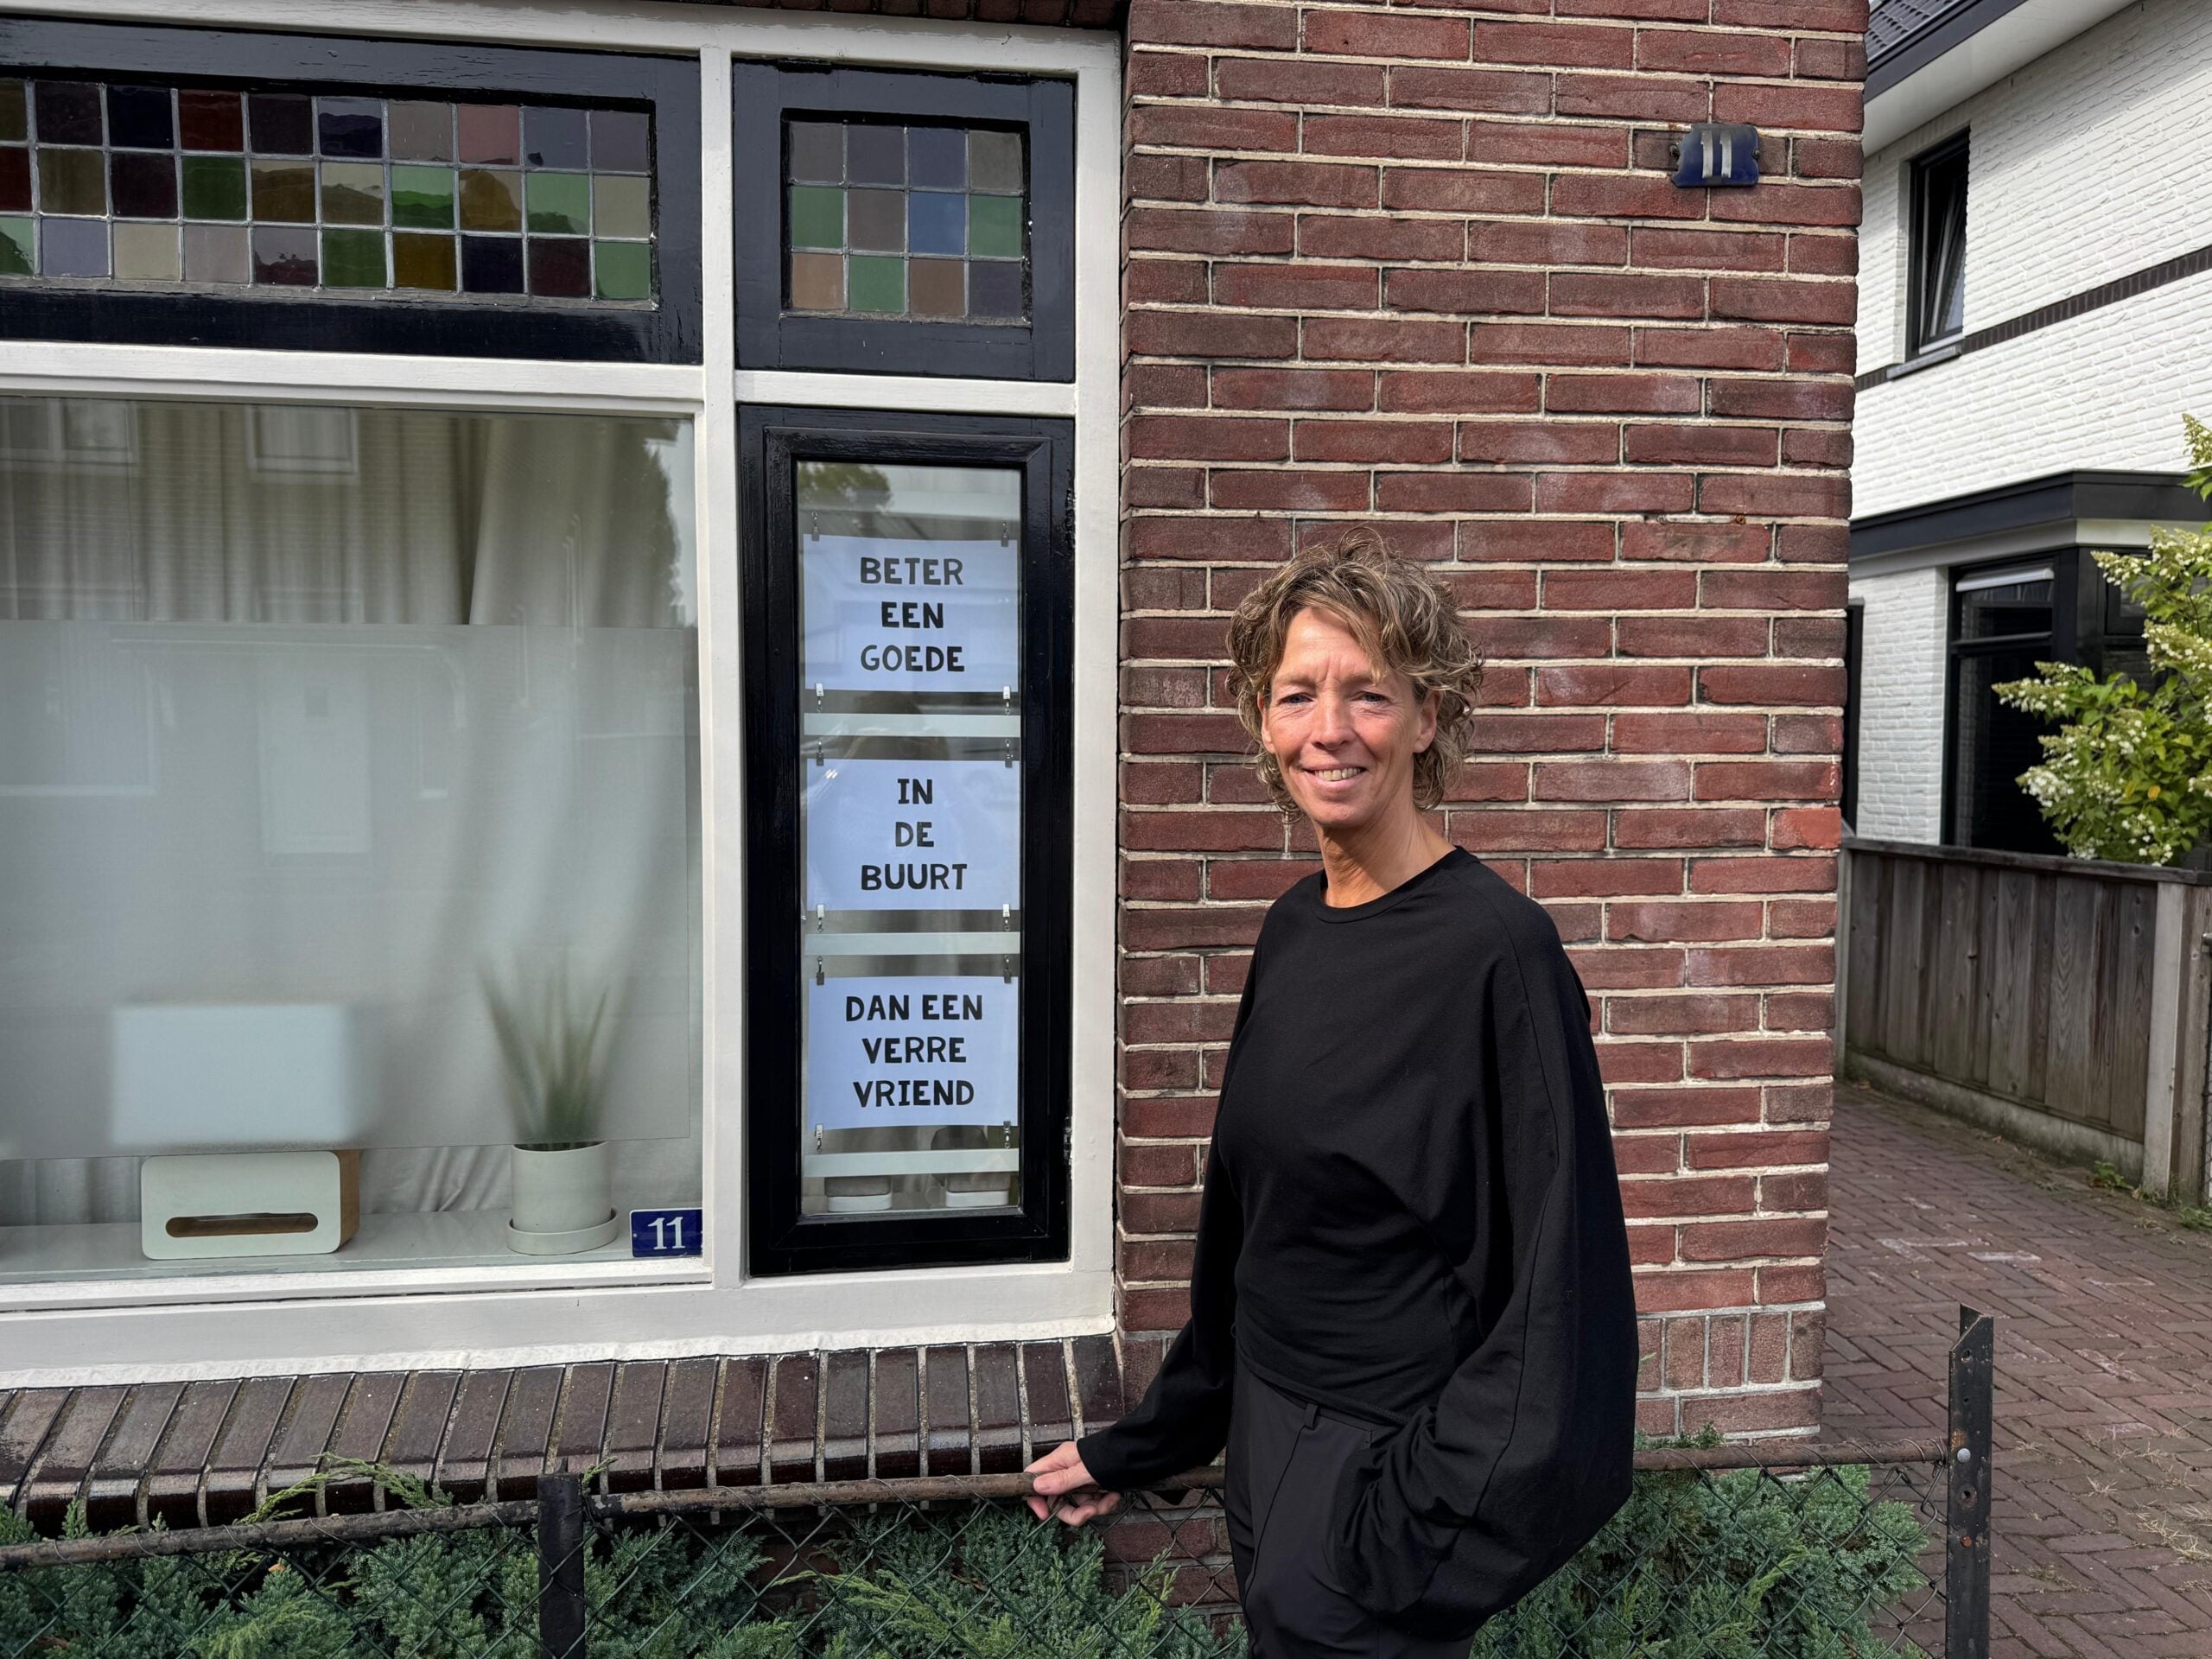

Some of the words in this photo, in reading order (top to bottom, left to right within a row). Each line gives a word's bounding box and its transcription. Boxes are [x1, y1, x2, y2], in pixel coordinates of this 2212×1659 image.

[1700, 130, 1732, 179] 11
[860, 556, 963, 585] BETER
[881, 601, 944, 629] EEN
[861, 645, 965, 672] GOEDE
[897, 779, 933, 804] IN
[895, 821, 935, 848] DE
[861, 863, 968, 891] BUURT
[845, 994, 910, 1022] DAN
[922, 994, 983, 1020] EEN
[861, 1036, 967, 1065] VERRE
[853, 1079, 975, 1108] VRIEND
[647, 1216, 686, 1250] 11
